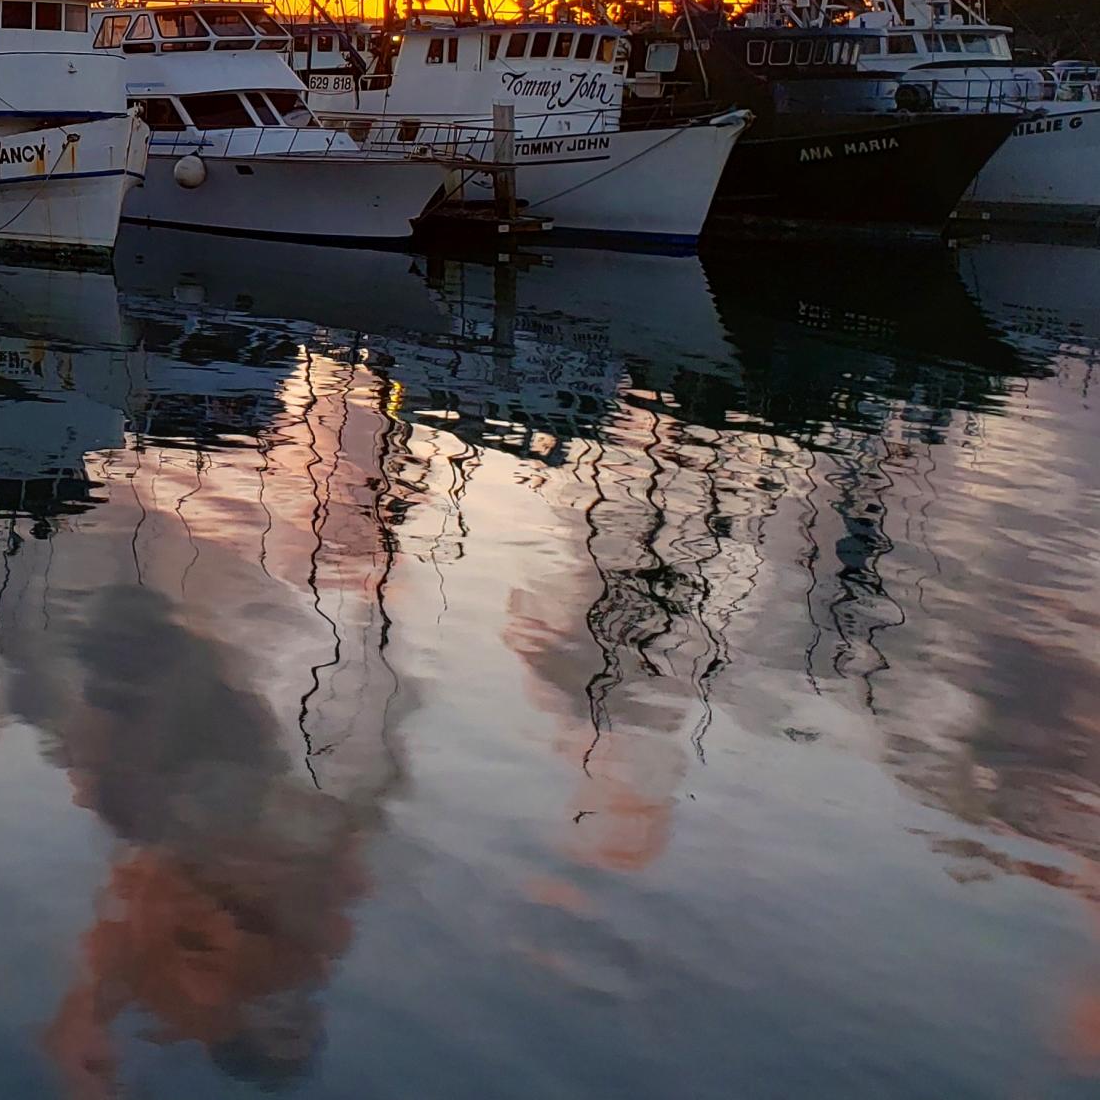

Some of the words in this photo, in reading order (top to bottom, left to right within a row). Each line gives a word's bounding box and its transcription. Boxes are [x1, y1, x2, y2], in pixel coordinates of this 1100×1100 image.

[310, 77, 329, 89] 629
[333, 77, 351, 90] 818
[502, 72, 561, 110] Tommy
[558, 72, 614, 107] John
[1069, 116, 1083, 129] G
[515, 140, 564, 156] TOMMY
[567, 137, 610, 151] JOHN
[800, 146, 833, 162] ANA
[844, 138, 899, 155] MARIA
